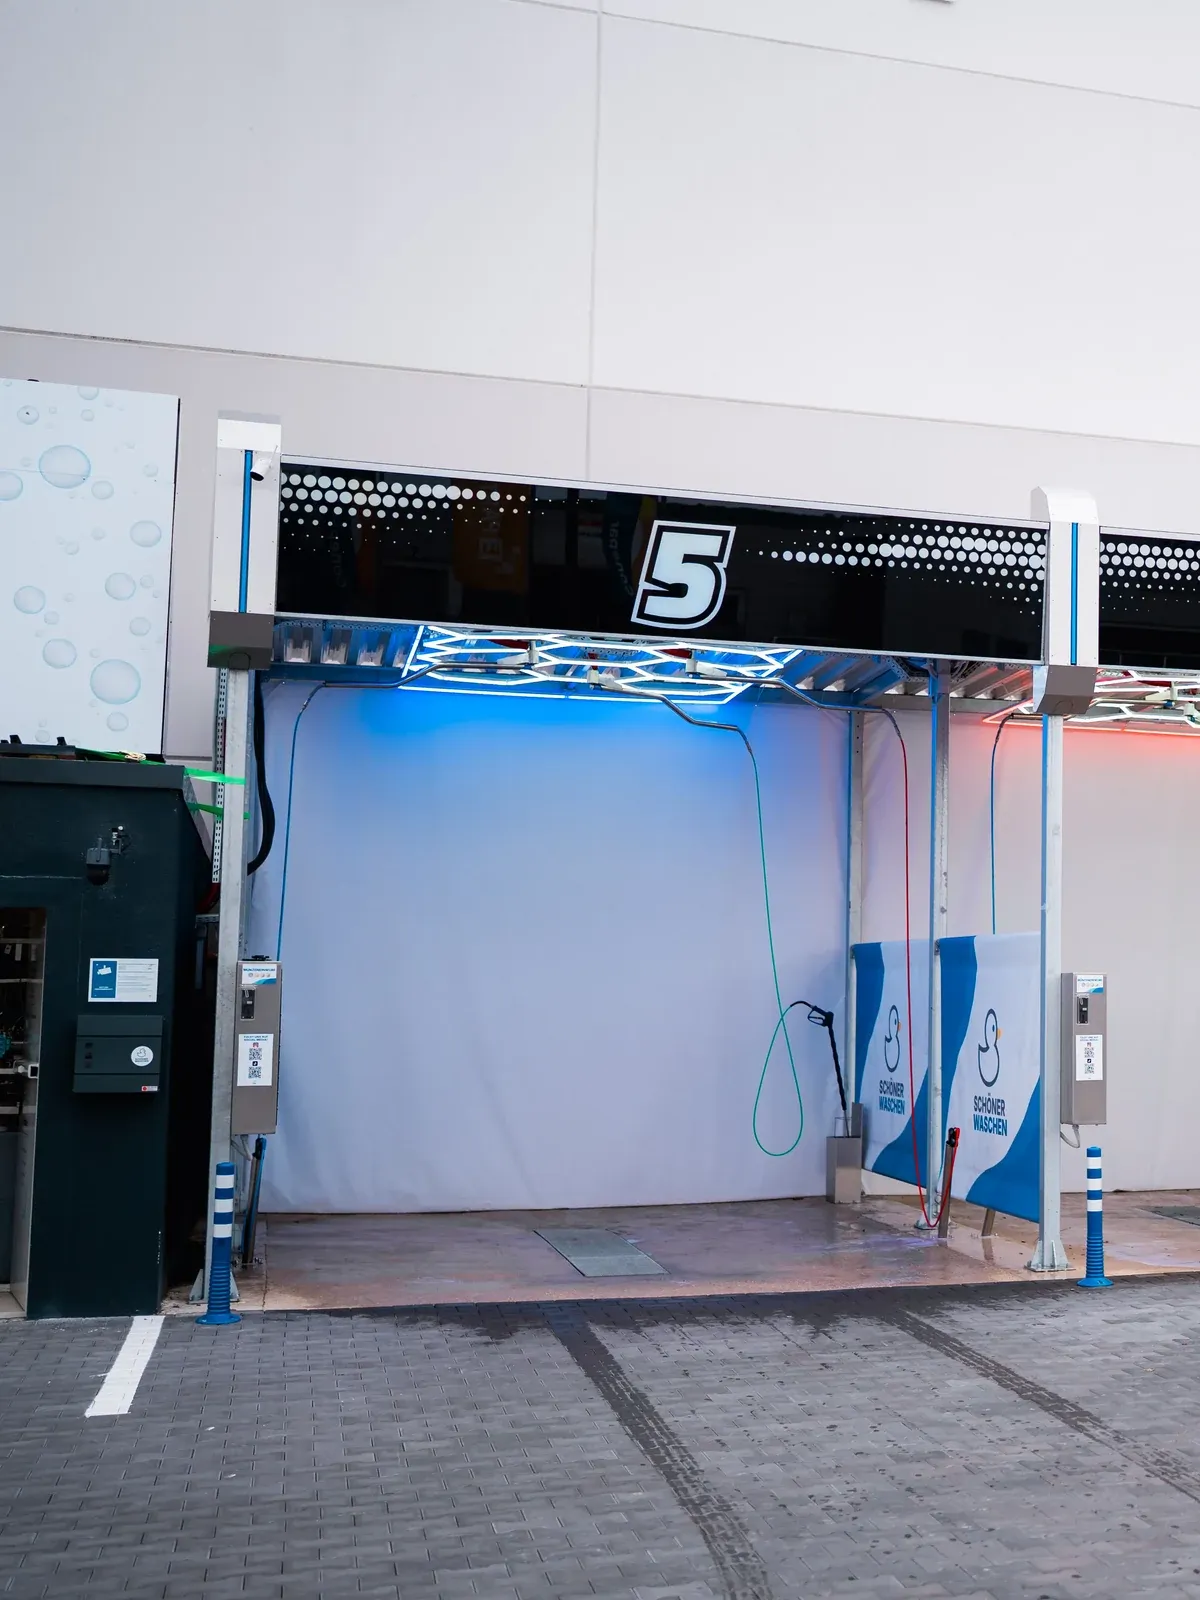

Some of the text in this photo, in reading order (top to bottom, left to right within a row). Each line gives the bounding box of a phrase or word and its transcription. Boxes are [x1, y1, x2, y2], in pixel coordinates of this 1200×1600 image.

[631, 520, 736, 629] 5
[879, 1078, 904, 1098] SCHÖNER
[879, 1095, 905, 1115] WASCHEN
[973, 1093, 1005, 1116] SCHÖNER
[973, 1114, 1007, 1136] WASCHEN
